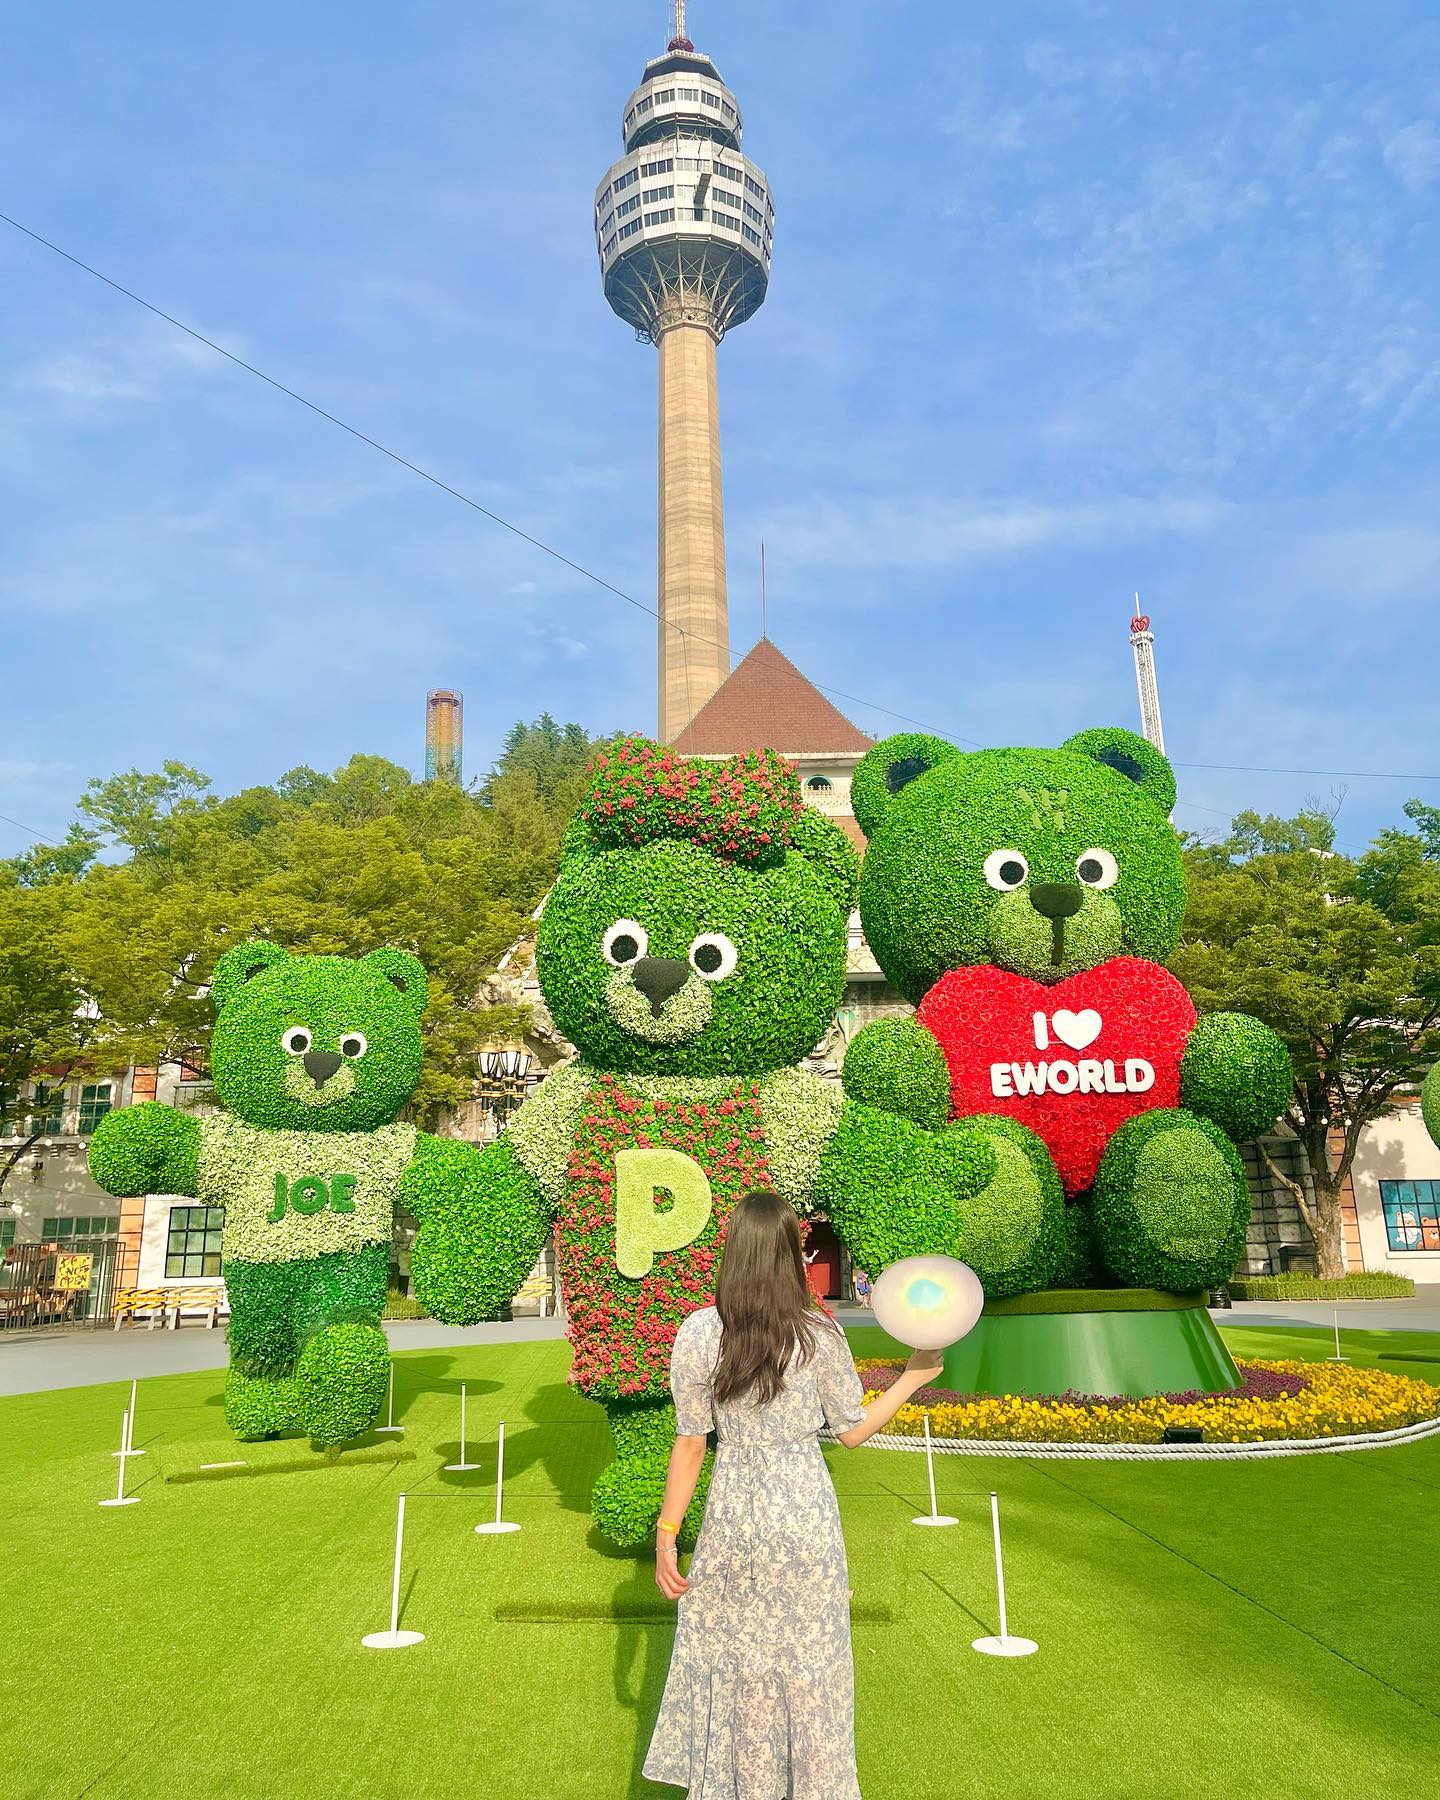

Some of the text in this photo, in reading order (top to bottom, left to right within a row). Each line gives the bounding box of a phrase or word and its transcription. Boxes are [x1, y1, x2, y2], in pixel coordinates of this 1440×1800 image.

[1033, 1011, 1048, 1050] I
[990, 1058, 1155, 1097] EWORLD
[267, 1172, 357, 1222] JOE
[616, 1149, 712, 1279] P
